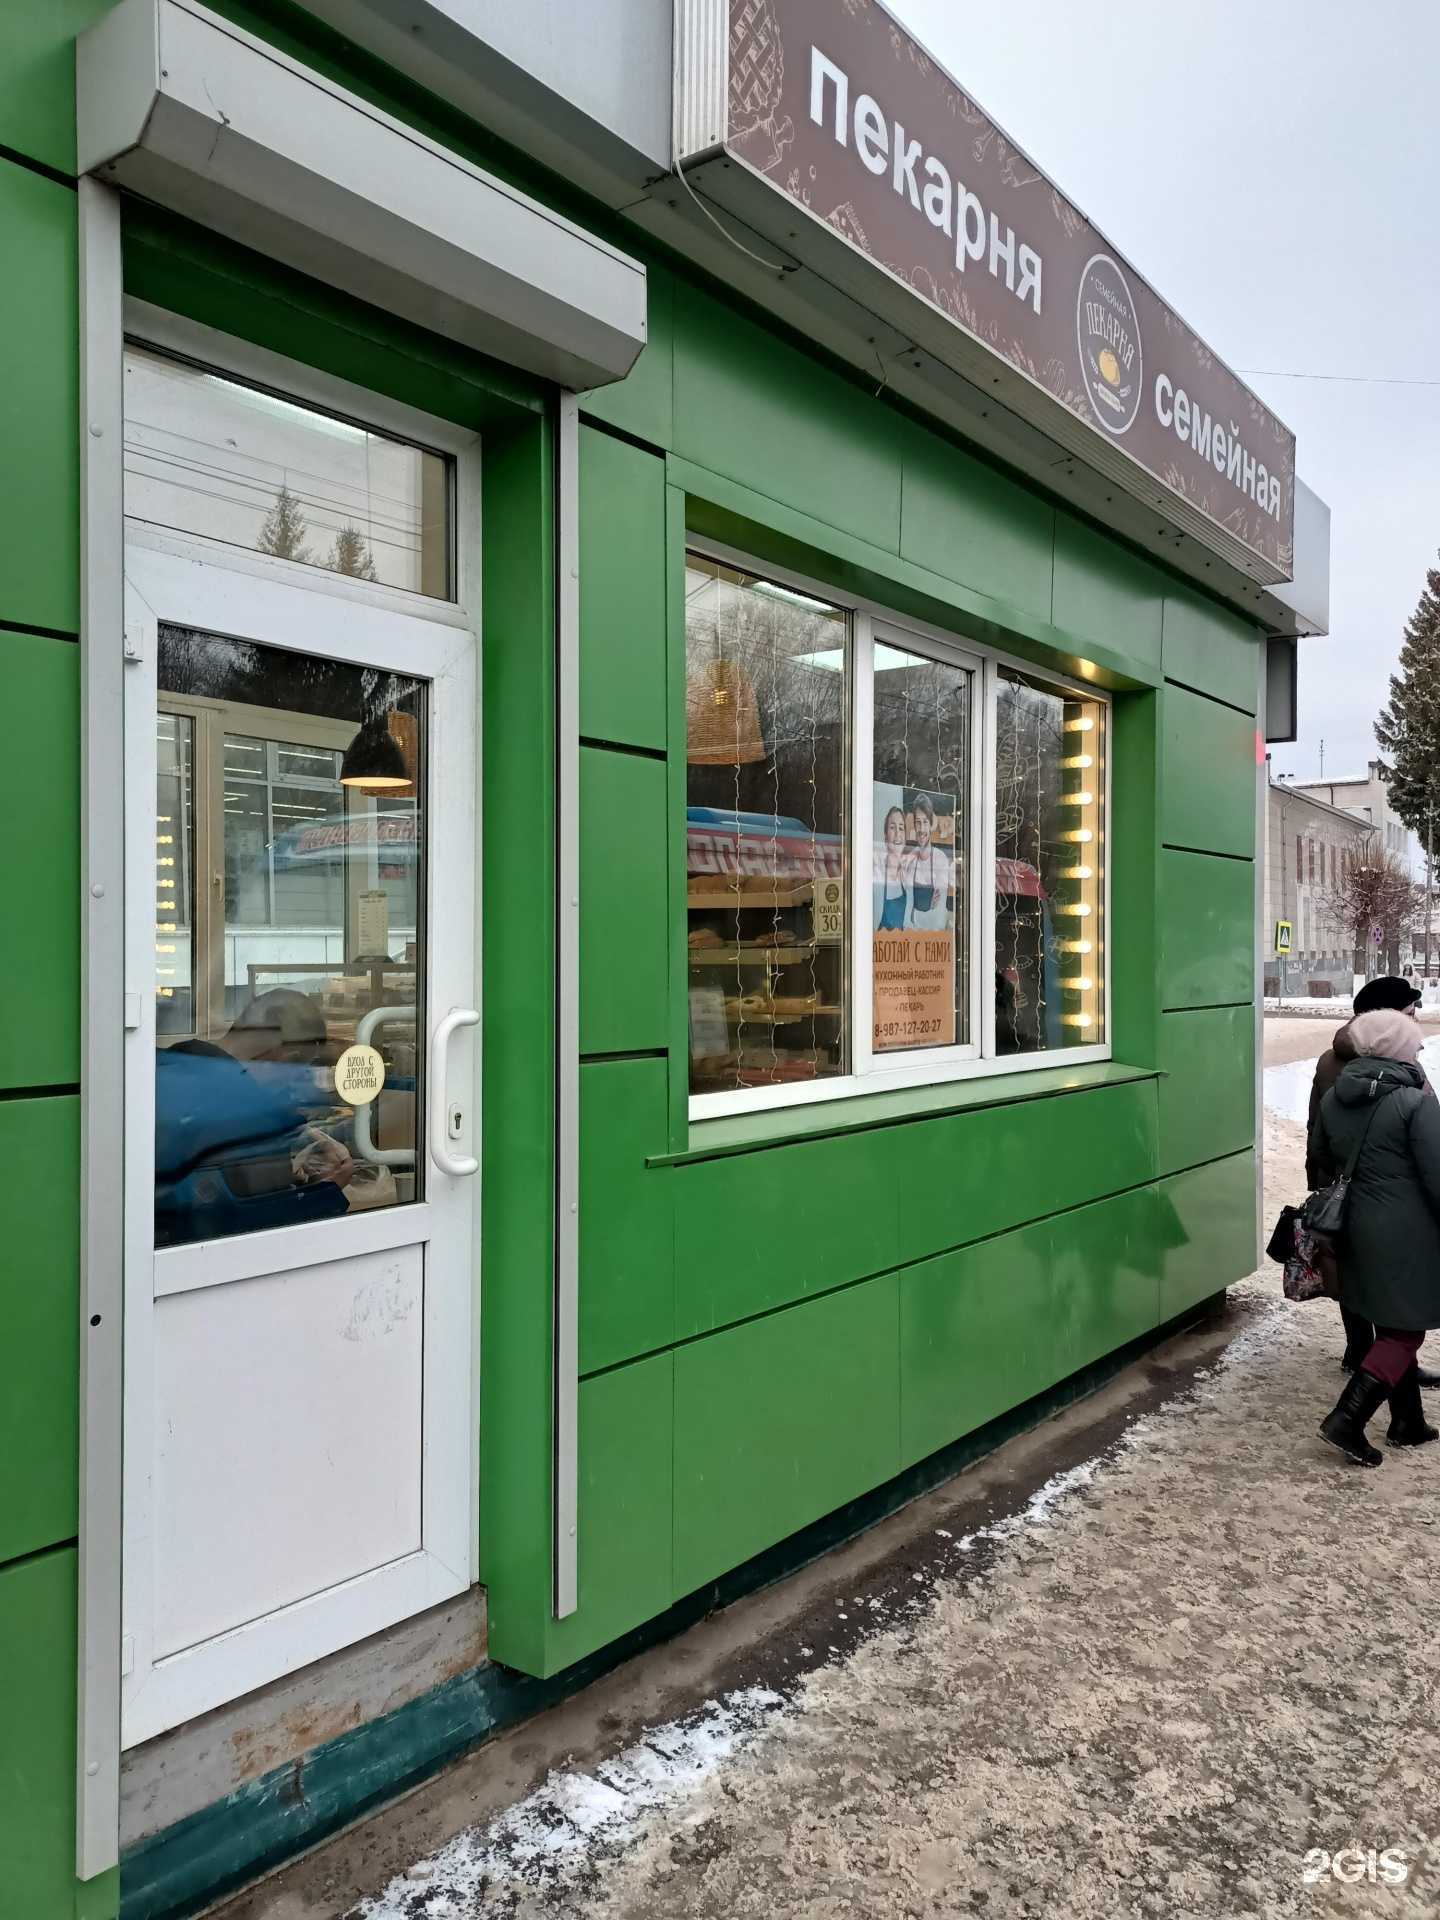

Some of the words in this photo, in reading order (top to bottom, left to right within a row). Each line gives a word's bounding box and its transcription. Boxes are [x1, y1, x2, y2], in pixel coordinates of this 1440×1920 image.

[810, 44, 1042, 316] пекарня
[1155, 373, 1281, 522] семейная
[1095, 278, 1127, 319] СЕМЕЙНАЯ
[1086, 301, 1135, 371] ПЕКАРНЯ
[915, 942, 921, 962] С
[925, 941, 951, 963] НАМИ
[874, 1019, 942, 1037] 8-987-127-20-27
[348, 1056, 365, 1067] ВХОД
[369, 1056, 374, 1066] С
[346, 1067, 374, 1079] ДРУГОЙ
[343, 1078, 377, 1090] СТОРОНЫ
